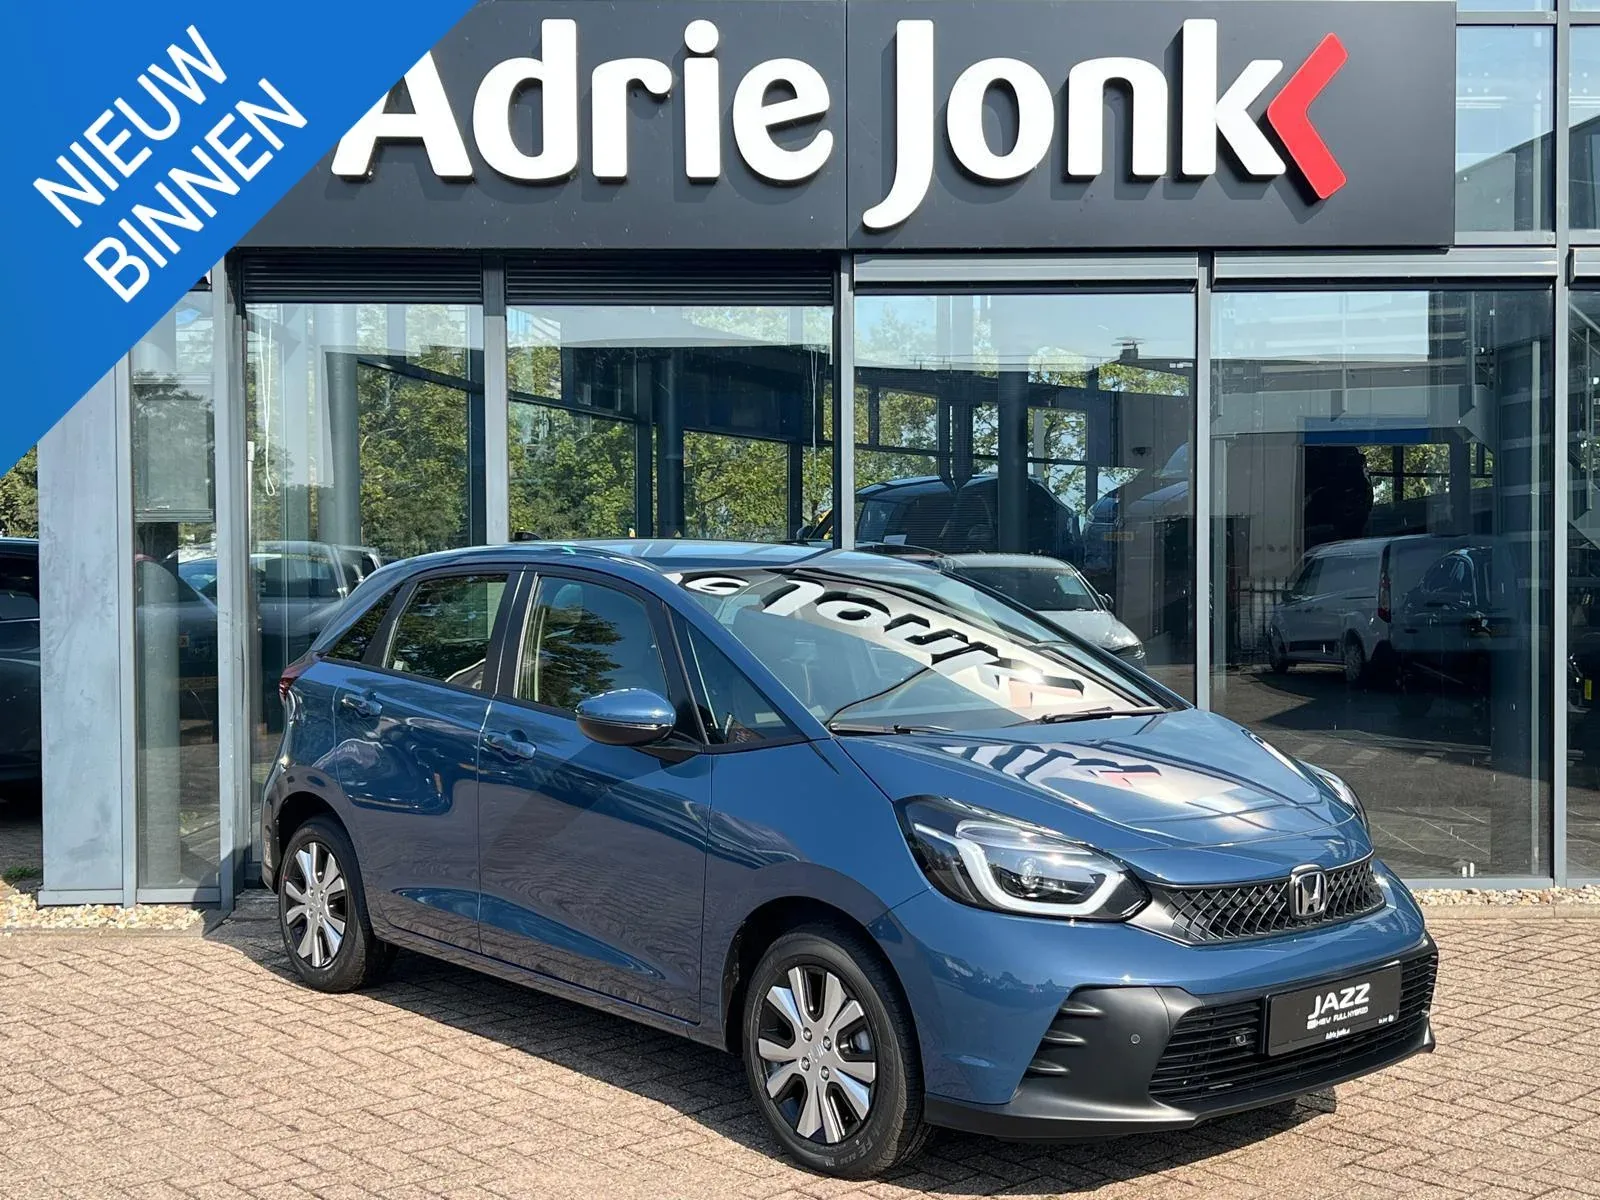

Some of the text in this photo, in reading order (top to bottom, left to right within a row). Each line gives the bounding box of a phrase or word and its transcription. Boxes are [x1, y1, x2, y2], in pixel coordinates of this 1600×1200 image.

[332, 19, 1286, 230] Adrie Jonk
[1307, 982, 1370, 1020] JAZZ
